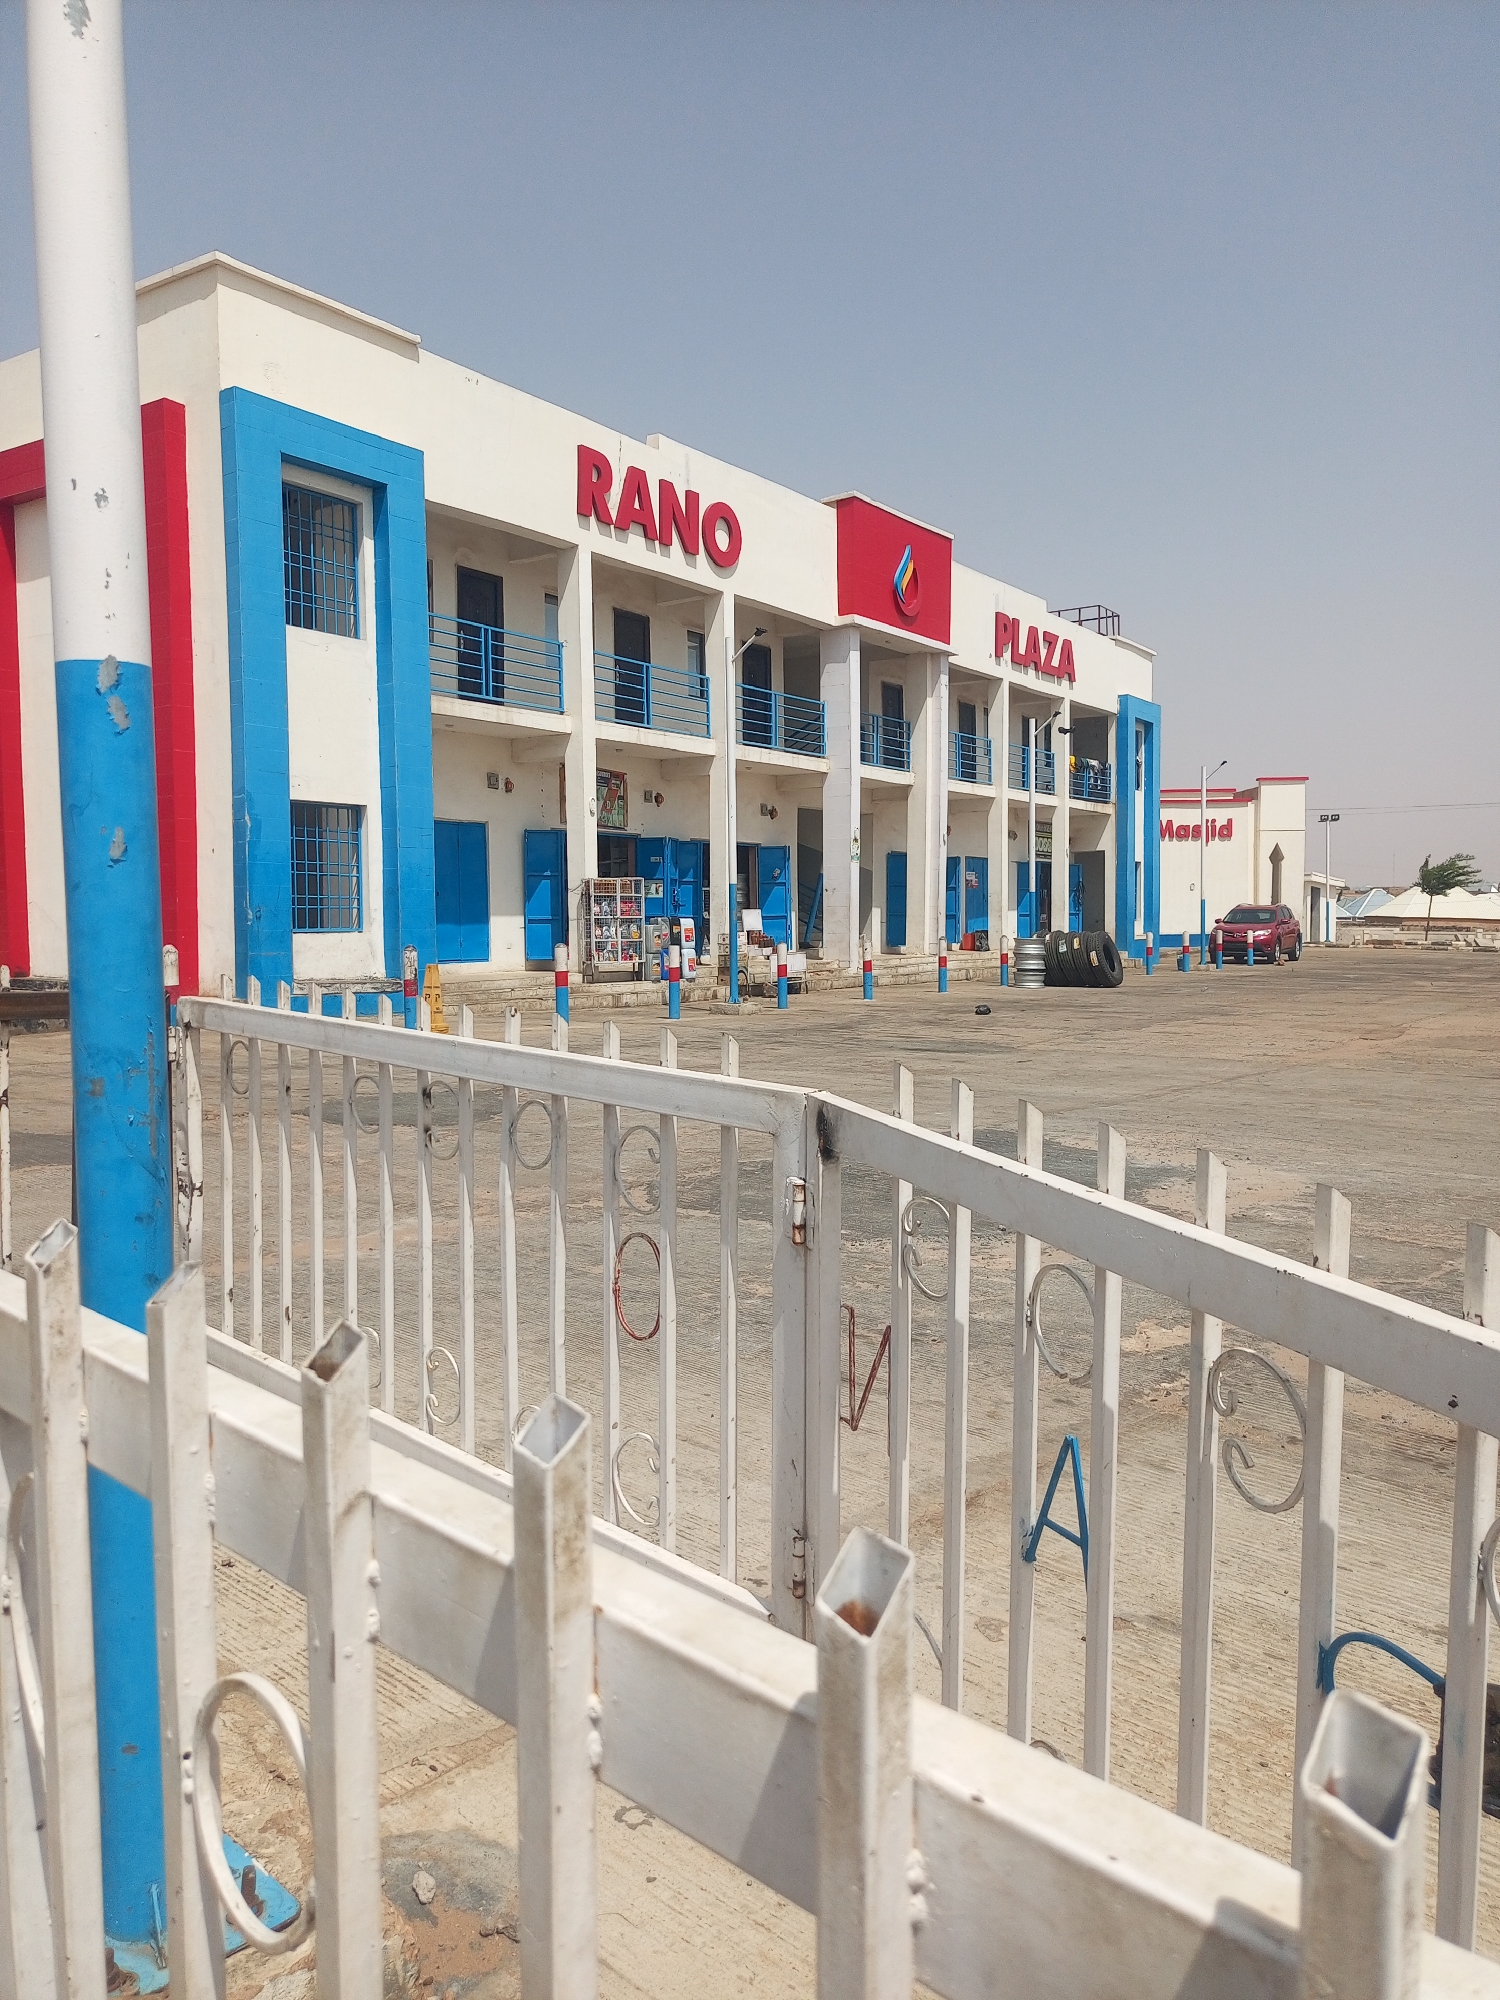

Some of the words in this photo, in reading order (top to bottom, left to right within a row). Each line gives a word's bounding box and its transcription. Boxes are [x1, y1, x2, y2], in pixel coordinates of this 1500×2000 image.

[577, 444, 742, 567] RANO
[995, 611, 1076, 682] PLAZA
[1160, 818, 1233, 844] Masjid
